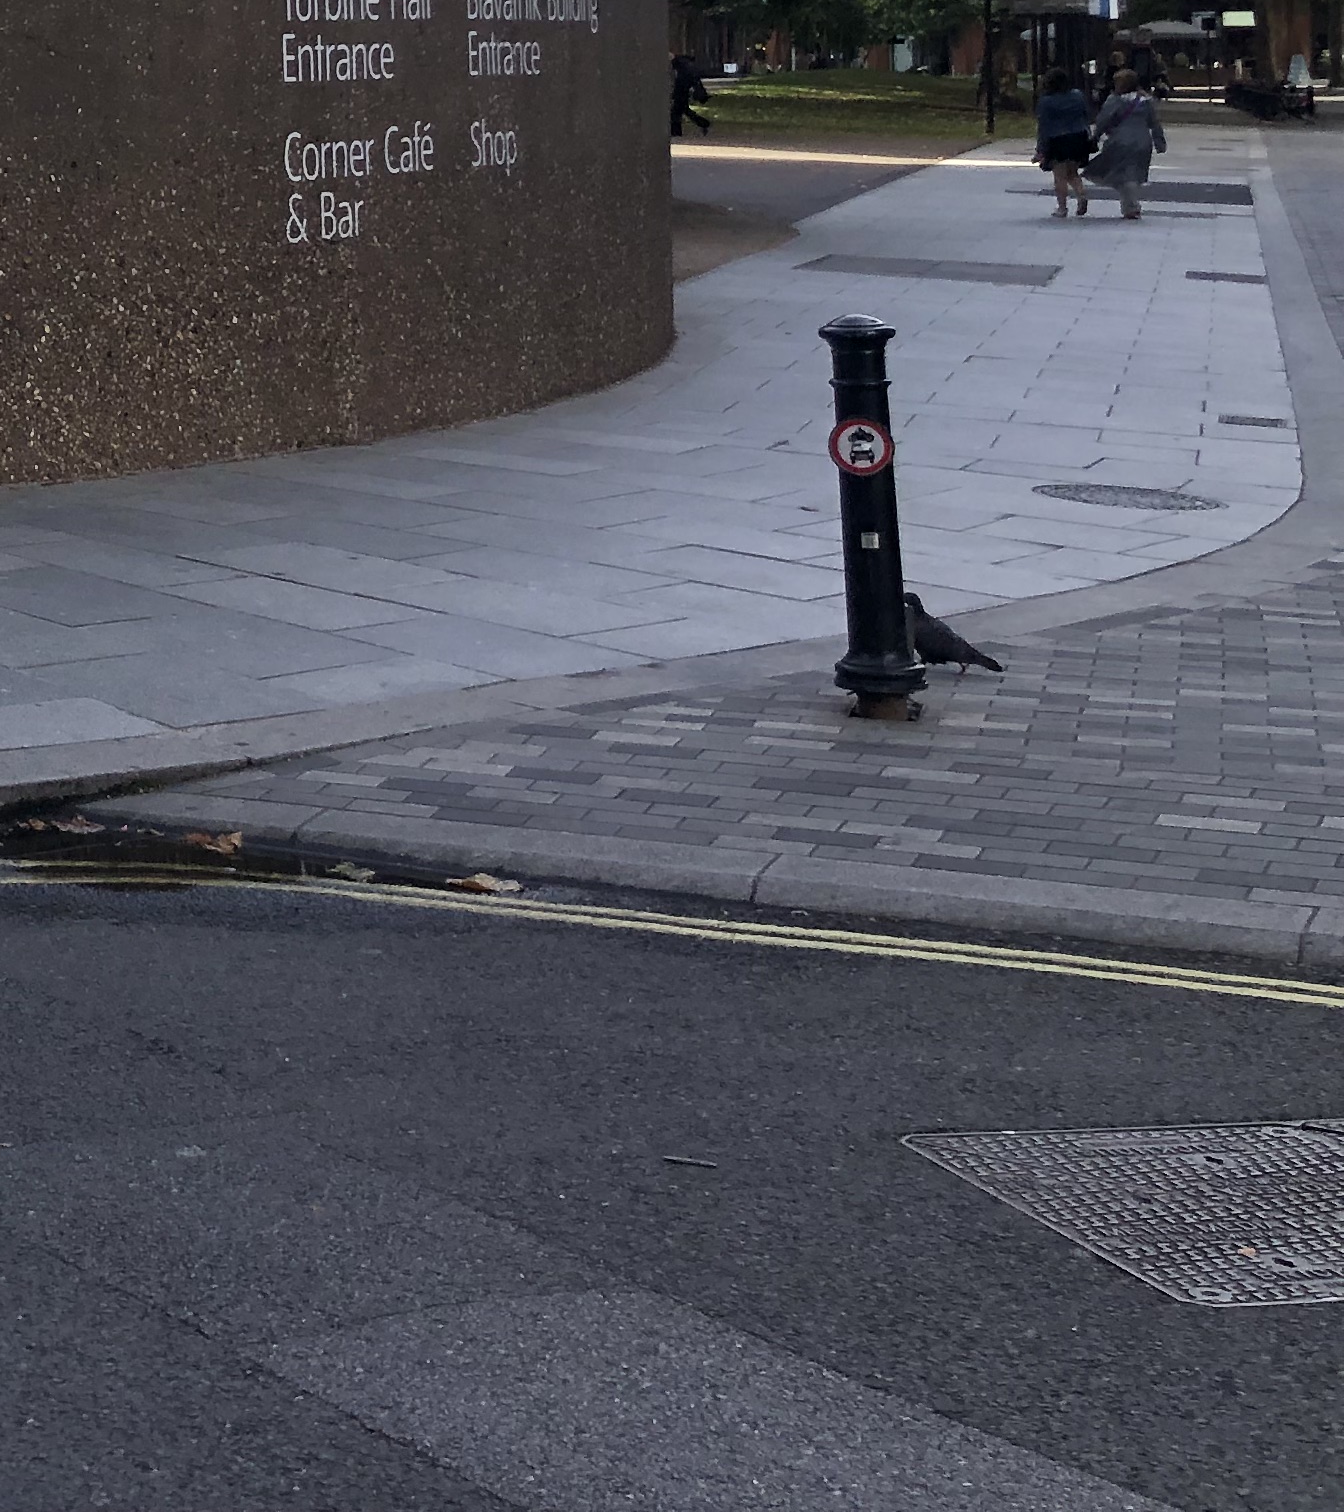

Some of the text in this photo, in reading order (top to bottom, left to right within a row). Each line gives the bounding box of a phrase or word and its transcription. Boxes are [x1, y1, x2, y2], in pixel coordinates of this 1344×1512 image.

[282, 34, 394, 82] Entrance
[468, 31, 541, 76] Entrance
[284, 120, 434, 182] Corner Café
[470, 119, 517, 176] Shop
[286, 191, 364, 243] & Bar
